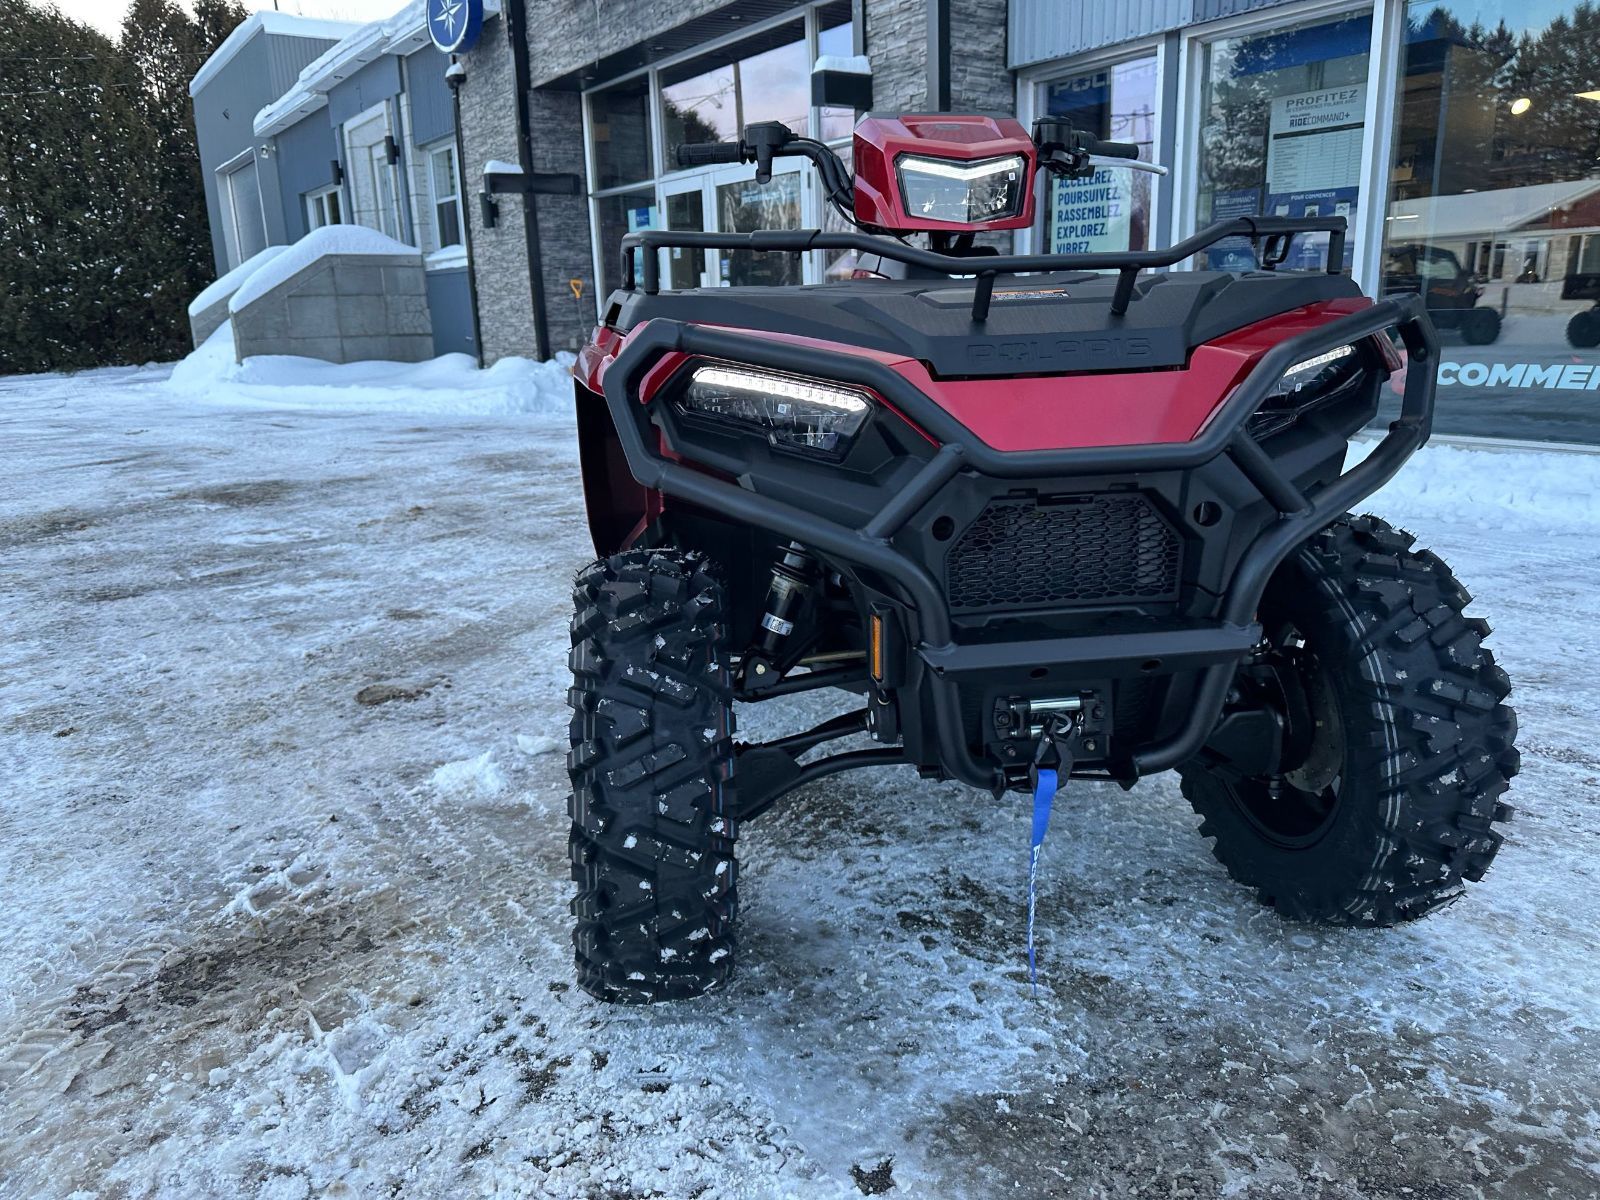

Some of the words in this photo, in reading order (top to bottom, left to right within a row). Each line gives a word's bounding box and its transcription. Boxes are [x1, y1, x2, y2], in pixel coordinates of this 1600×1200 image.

[1286, 89, 1358, 108] PROFITEZ
[1058, 187, 1121, 206] POURSUIVEZ.
[1057, 204, 1122, 223] RASSEMBLEZ.
[1057, 223, 1108, 239] EXPLOREZ.
[1056, 241, 1092, 254] VIBREZ.
[967, 337, 1153, 364] POLARIS
